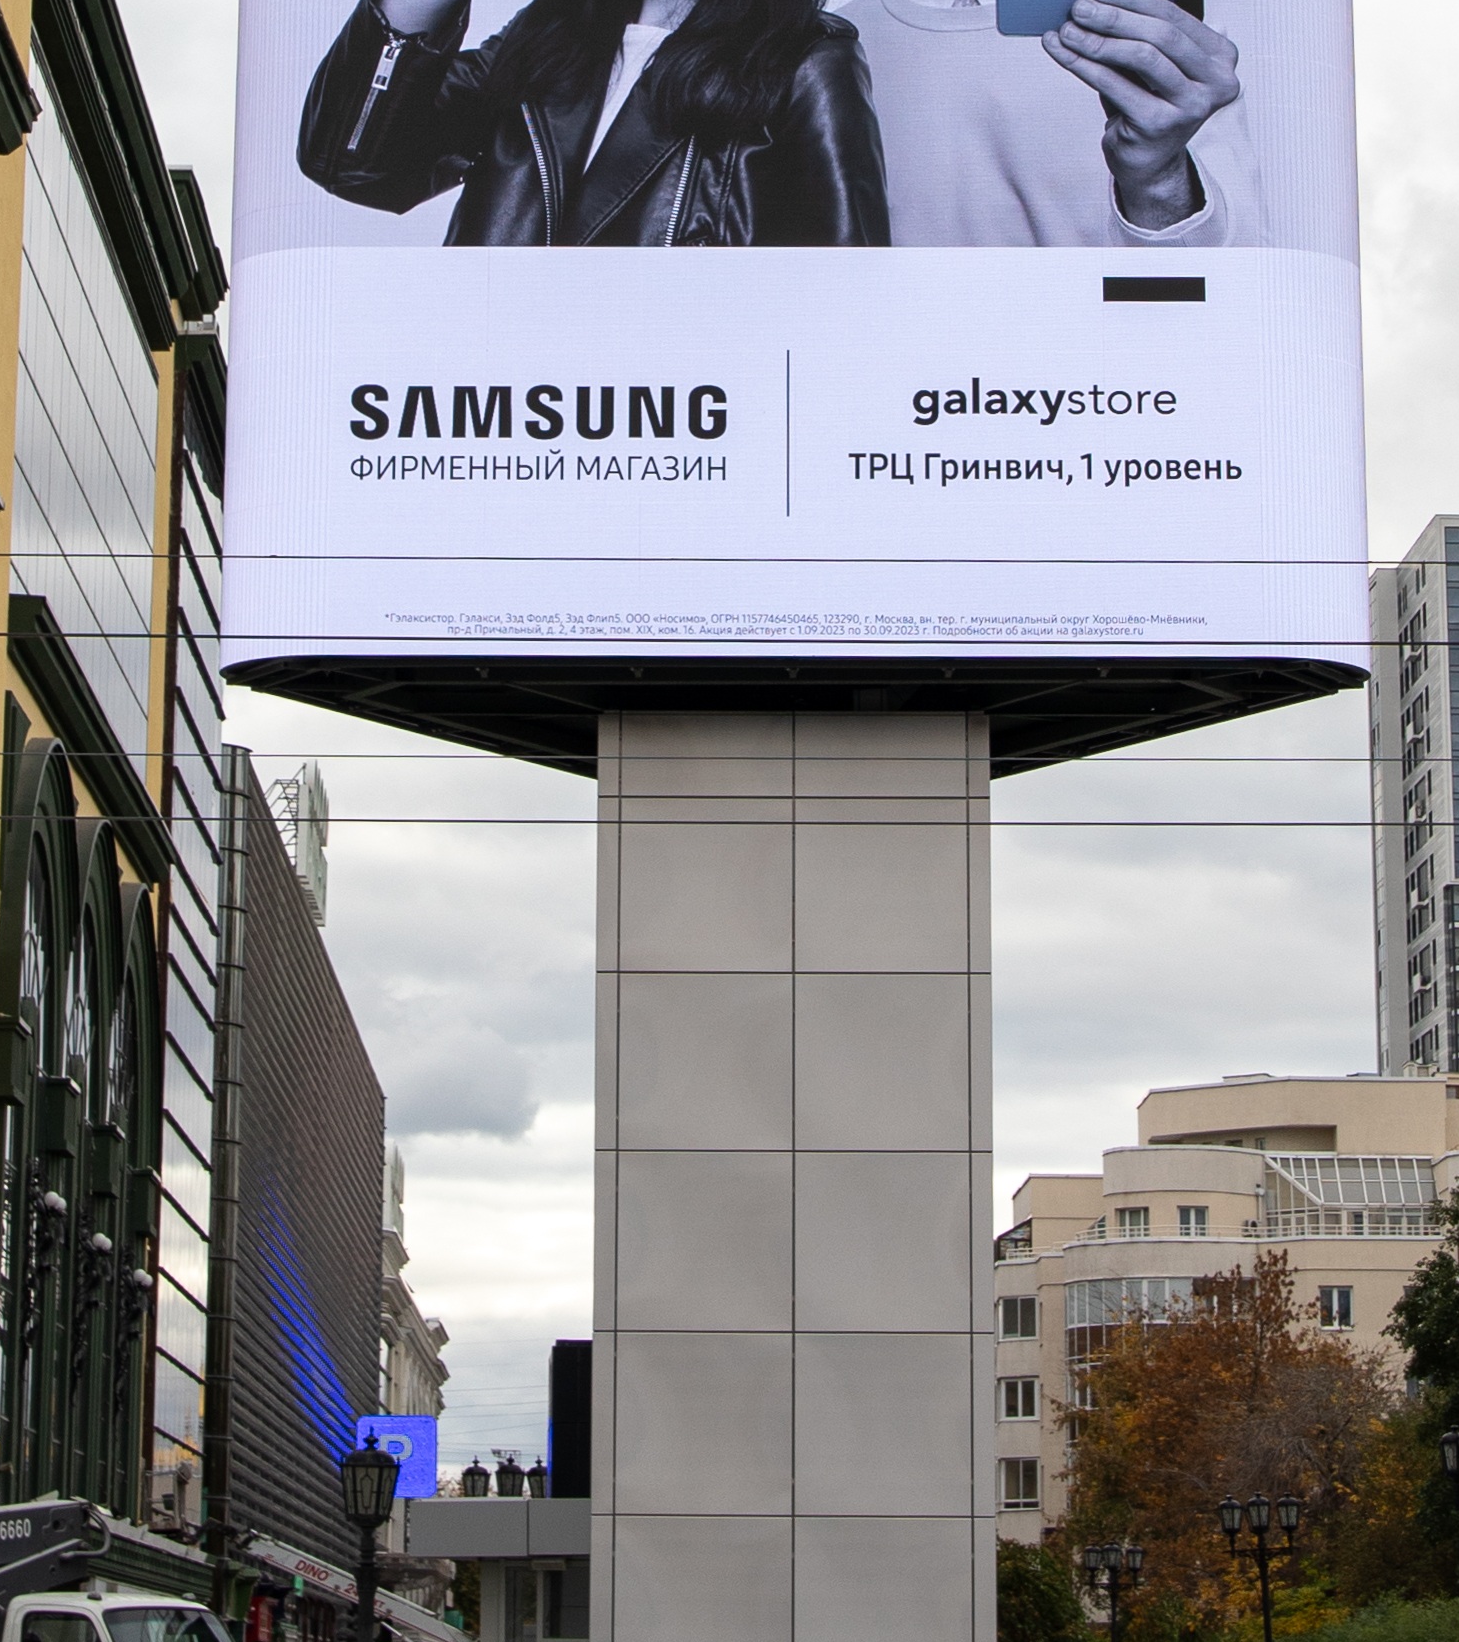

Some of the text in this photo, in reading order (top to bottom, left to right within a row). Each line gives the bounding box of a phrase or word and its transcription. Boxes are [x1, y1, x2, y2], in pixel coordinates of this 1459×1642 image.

[349, 383, 728, 442] SAMSUNG
[912, 377, 1178, 426] galaxystore
[350, 448, 727, 483] ФИРМЕННЫЙ МАГАЗИН
[848, 452, 1243, 490] ТРЦ Гринвич, 1 уровень
[459, 613, 504, 625] Гэлакси,
[526, 613, 563, 626] Фолд5,
[586, 614, 624, 624] Флип5.
[626, 614, 650, 624] ООО
[652, 614, 708, 626] «Носимо»,
[710, 614, 740, 624] ОГРН
[823, 614, 862, 627] 123290,
[874, 614, 917, 627] Москва,
[937, 617, 958, 627] тер.
[970, 615, 1058, 627] муниципальный
[1060, 617, 1090, 627] округ
[474, 625, 542, 637] Причальный,
[578, 627, 607, 637] этаж,
[609, 627, 634, 635] пом.
[658, 627, 681, 636] ком.
[698, 625, 732, 637] Акция
[734, 625, 787, 638] действует
[797, 626, 845, 636] 1.09.2023
[848, 628, 861, 636] по
[864, 626, 920, 636] 30.09.2023
[932, 626, 1003, 638] Подробности
[1005, 626, 1018, 637] об
[1020, 628, 1054, 638] акции
[1056, 628, 1069, 637] на
[1070, 626, 1144, 638] galaxystore.ru
[295, 1559, 330, 1581] DINO
